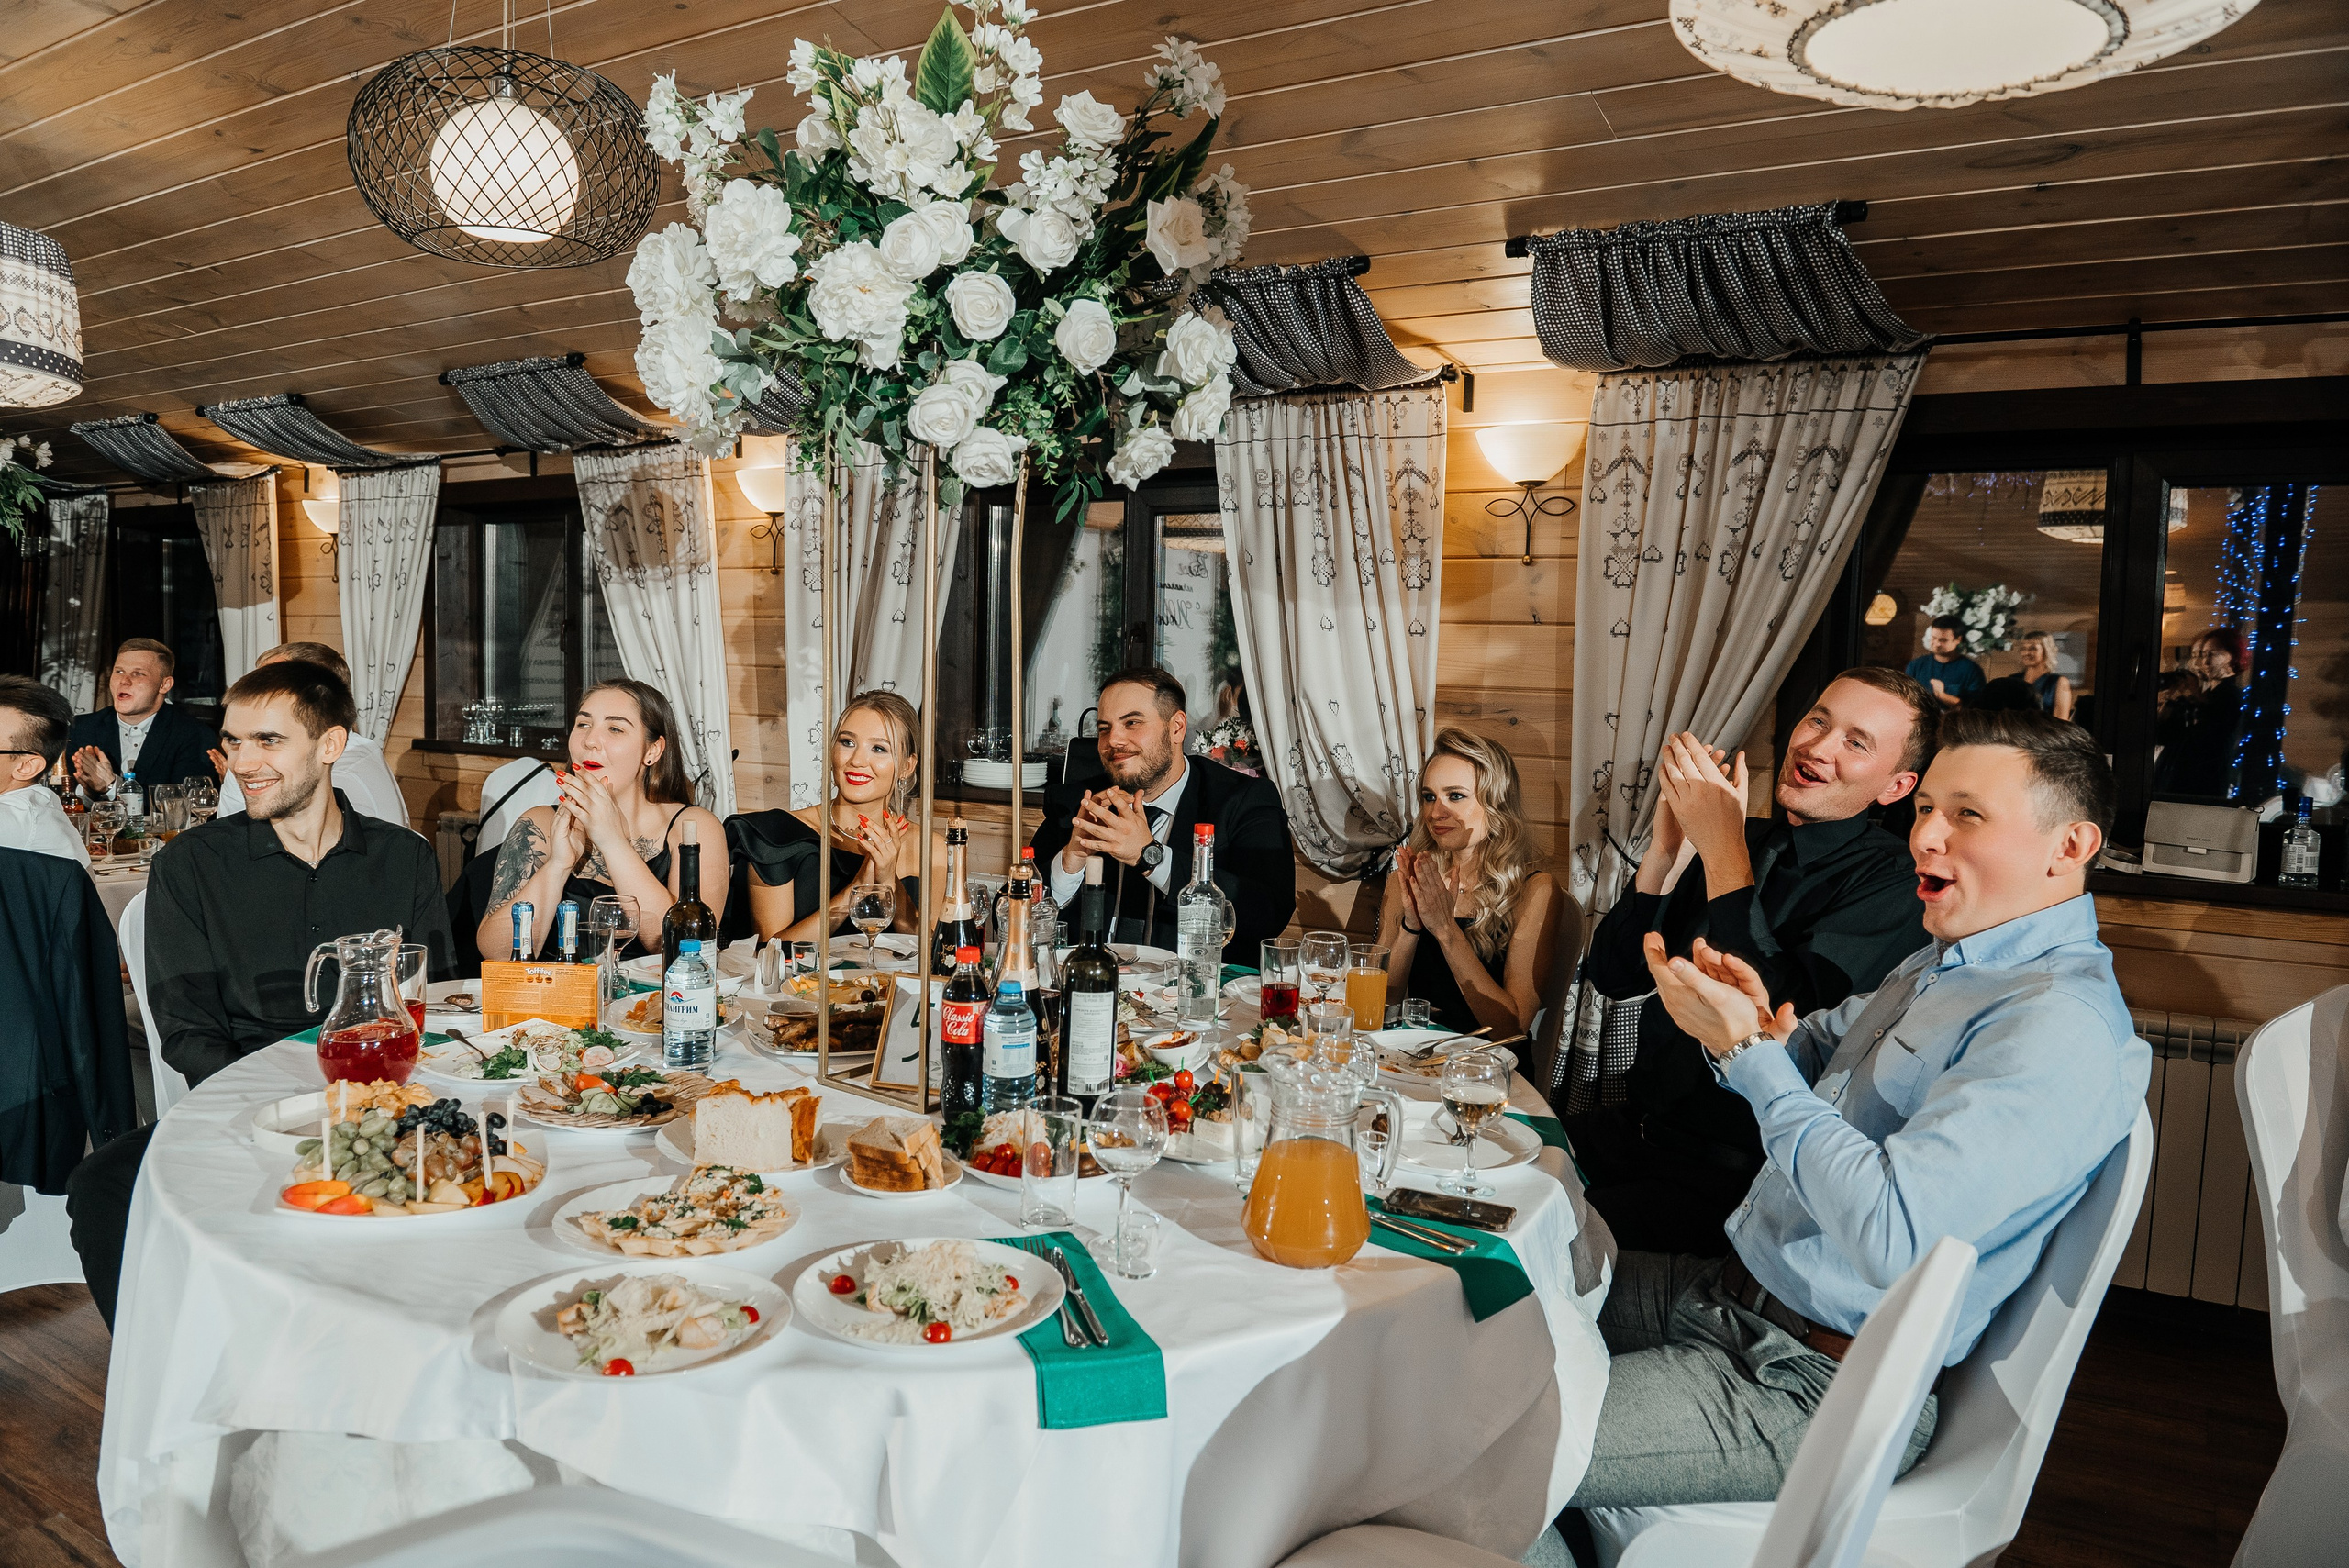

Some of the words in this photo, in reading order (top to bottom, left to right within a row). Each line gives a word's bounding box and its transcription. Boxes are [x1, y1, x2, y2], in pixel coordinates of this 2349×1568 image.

[525, 967, 553, 976] Toffifee
[942, 1006, 974, 1023] Classic
[946, 1020, 970, 1036] Cola
